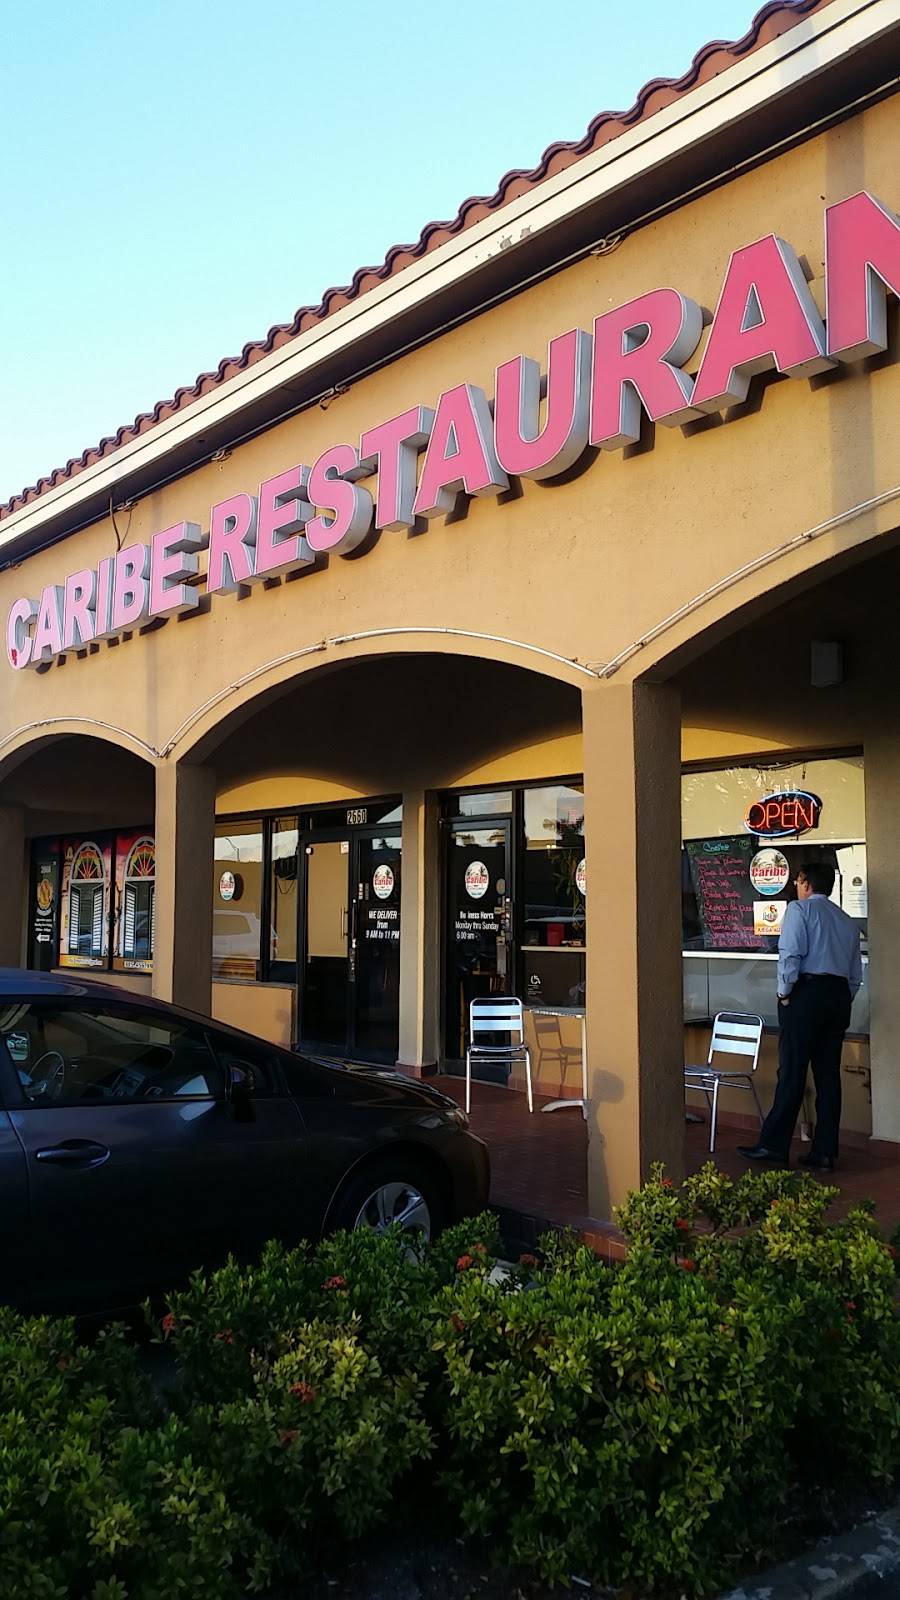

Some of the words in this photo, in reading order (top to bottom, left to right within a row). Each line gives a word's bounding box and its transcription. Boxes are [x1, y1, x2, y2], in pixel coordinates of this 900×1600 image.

[7, 521, 198, 671] CARIBE
[347, 809, 367, 824] 2660
[744, 801, 814, 828] OPEN
[752, 867, 787, 877] Caribe
[369, 910, 377, 919] WE
[377, 910, 397, 919] DELIVER
[459, 911, 480, 919] Buiness
[376, 920, 388, 929] from
[455, 921, 472, 931] Monday
[473, 921, 481, 930] thru
[482, 921, 499, 932] Sunday
[370, 930, 378, 939] AM
[391, 931, 399, 939] PM
